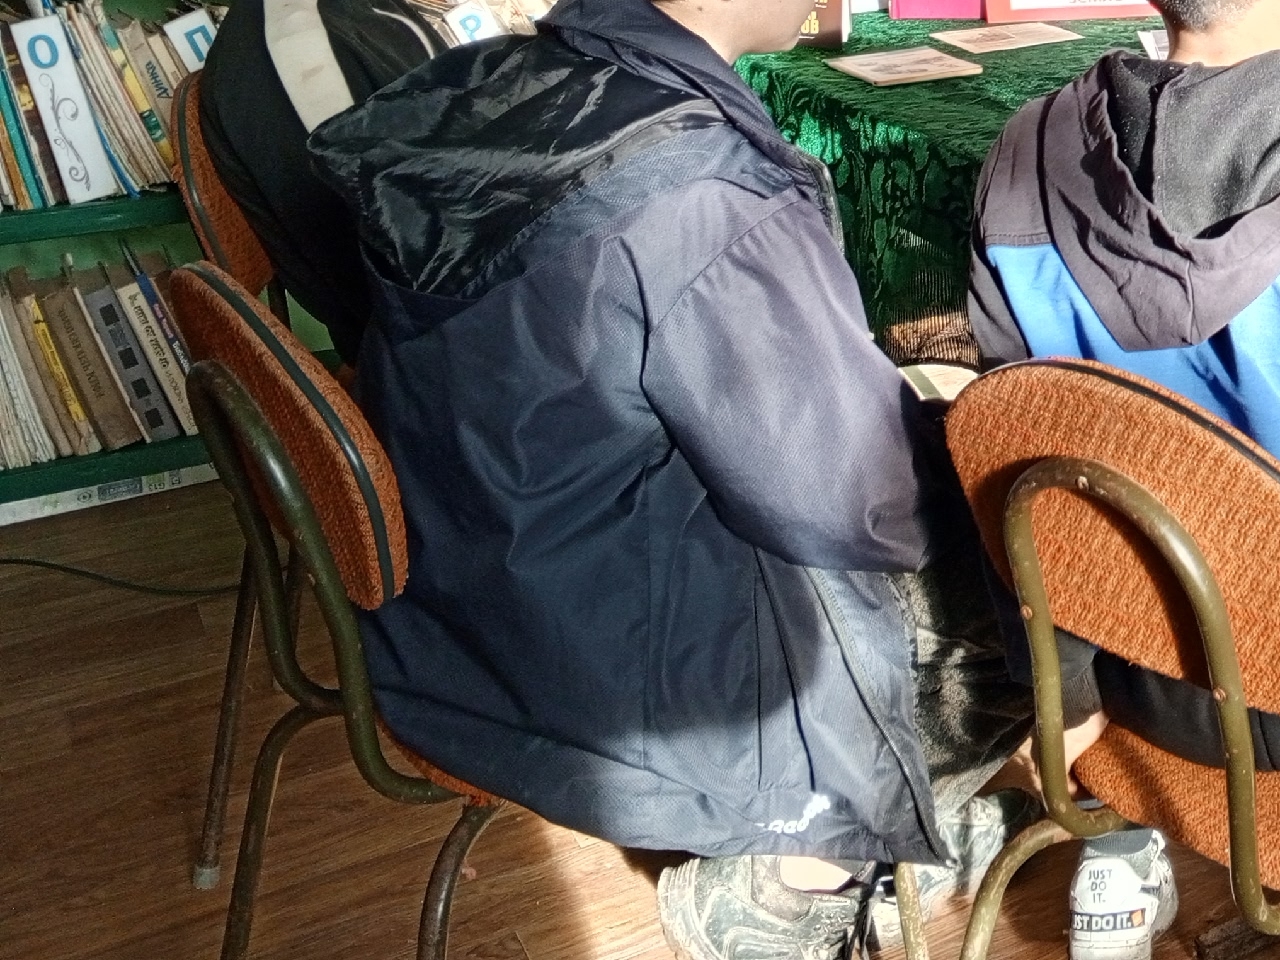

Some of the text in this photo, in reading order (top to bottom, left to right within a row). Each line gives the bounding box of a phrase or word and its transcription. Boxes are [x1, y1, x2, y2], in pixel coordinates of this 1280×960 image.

[459, 15, 483, 42] Р
[27, 34, 59, 69] О
[1088, 869, 1112, 881] JUST
[1091, 882, 1107, 892] DO
[1092, 893, 1107, 904] IT.
[1092, 914, 1114, 930] DO
[1116, 912, 1132, 928] IT.
